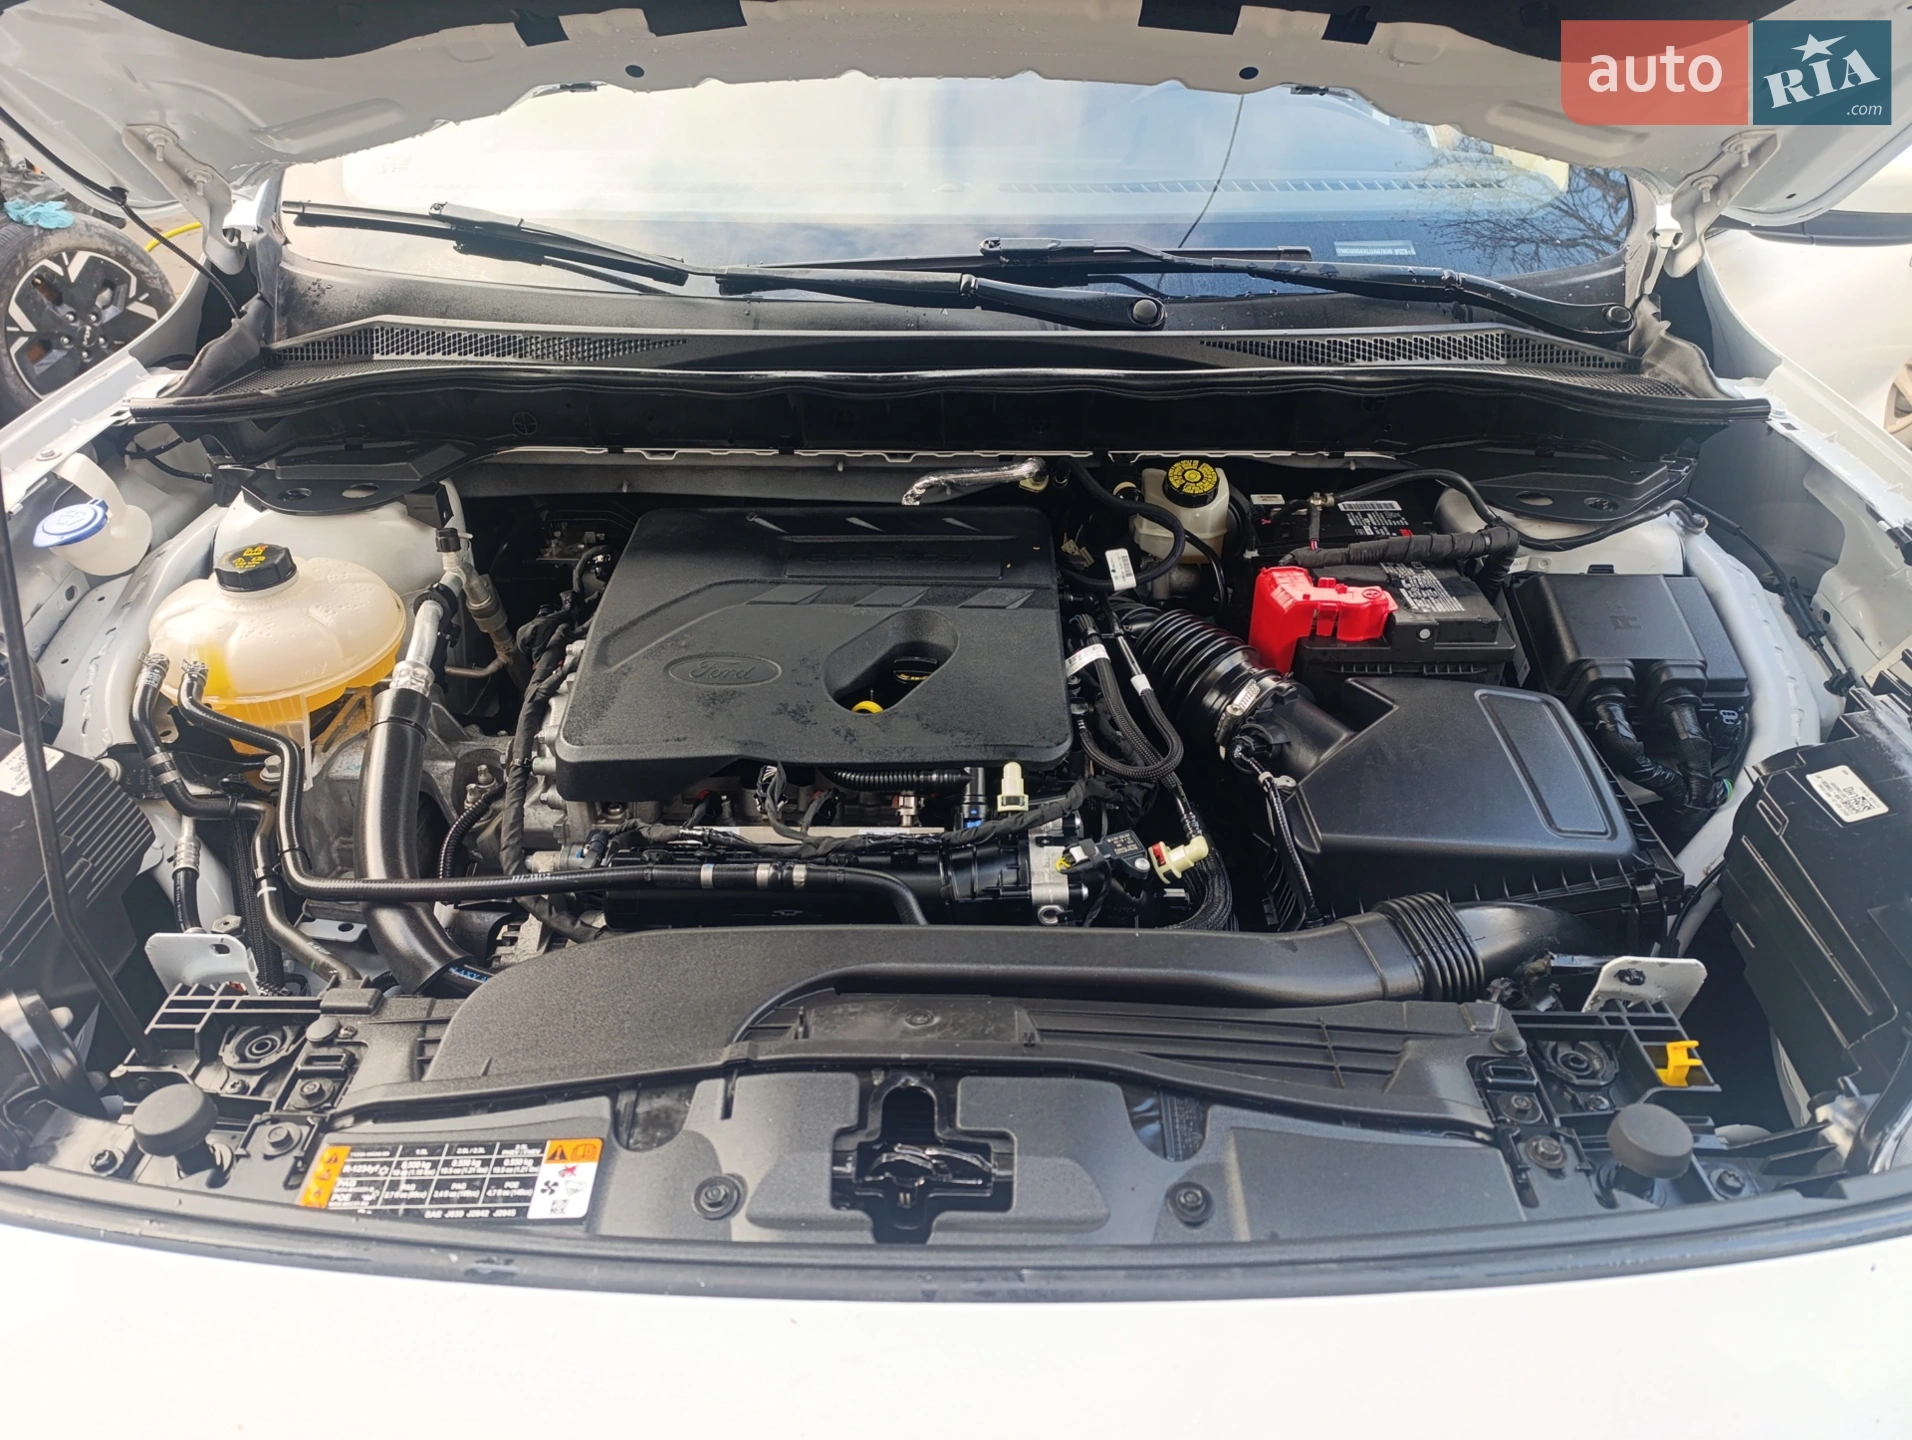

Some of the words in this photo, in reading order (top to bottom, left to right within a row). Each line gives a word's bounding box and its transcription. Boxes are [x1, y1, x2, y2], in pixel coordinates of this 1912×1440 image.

[689, 660, 755, 679] Ford
[420, 1160, 432, 1170] kg
[471, 1159, 482, 1168] kg
[523, 1158, 534, 1168] kg
[343, 1165, 379, 1175] R-1234yf
[424, 1210, 442, 1218] SAE
